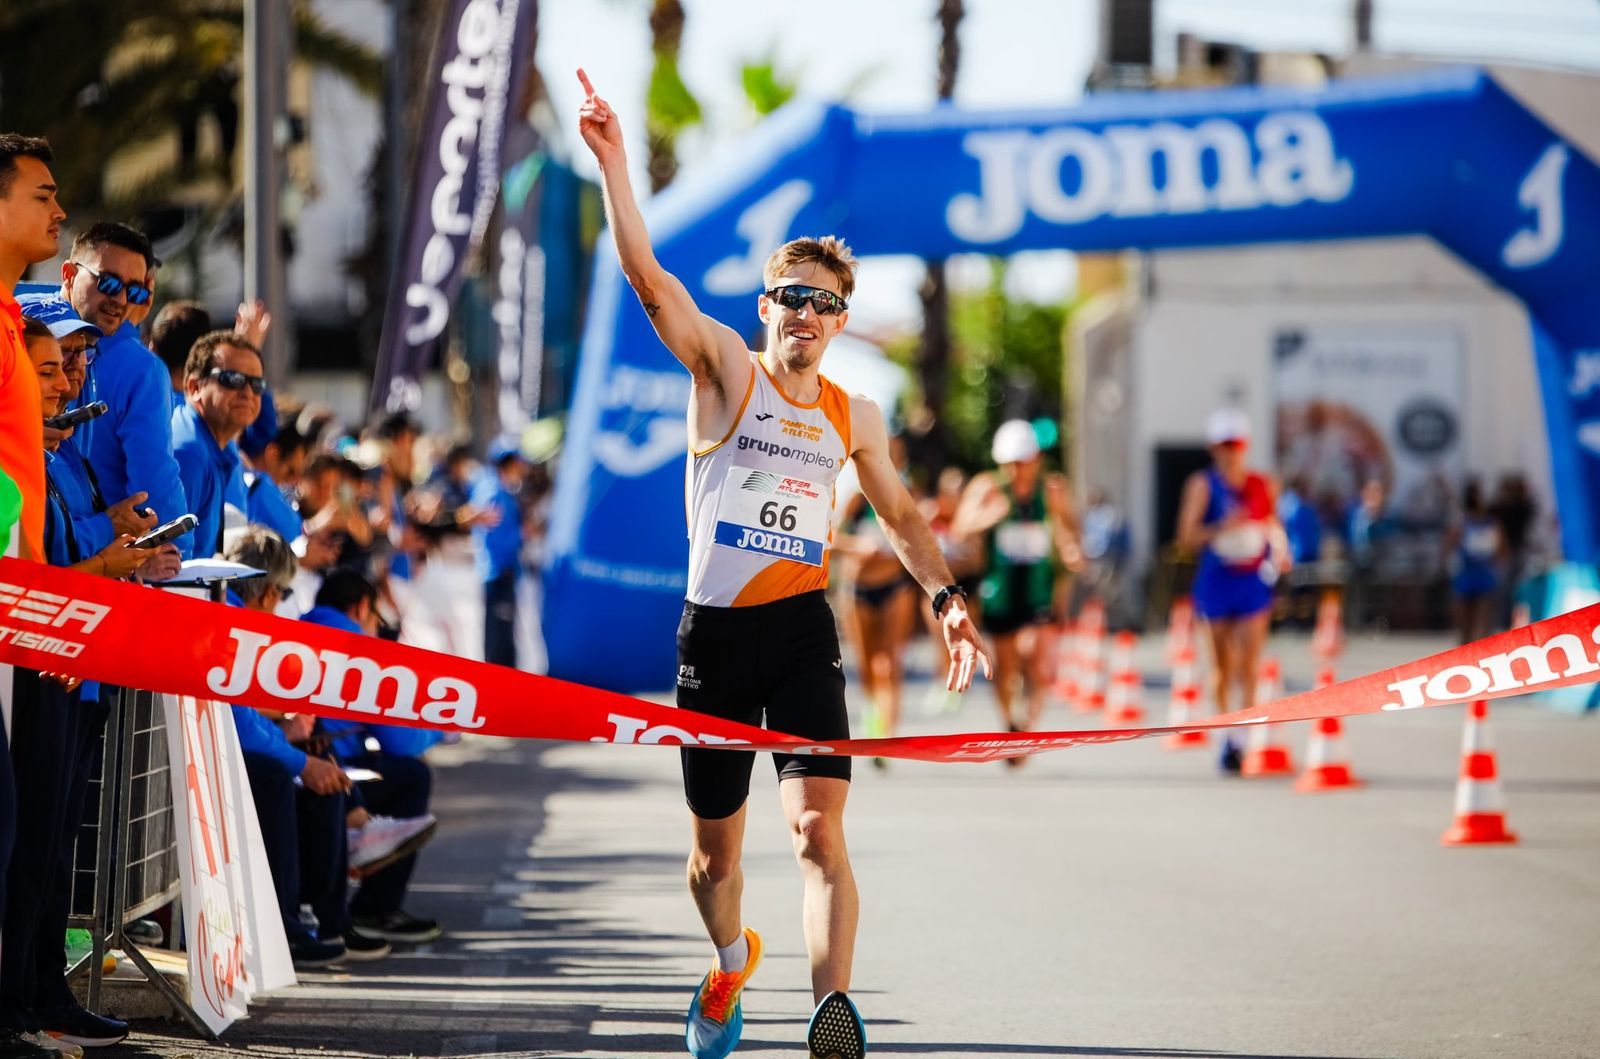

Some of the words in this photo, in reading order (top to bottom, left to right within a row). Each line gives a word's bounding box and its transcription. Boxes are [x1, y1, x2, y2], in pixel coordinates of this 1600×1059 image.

[946, 111, 1353, 243] Joma
[779, 418, 823, 433] PAMPLONA
[737, 435, 834, 469] grupompleo
[760, 501, 797, 532] 66
[737, 528, 806, 558] Joma
[206, 627, 486, 729] Joma
[679, 664, 695, 678] PA
[1381, 624, 1600, 711] Jom
